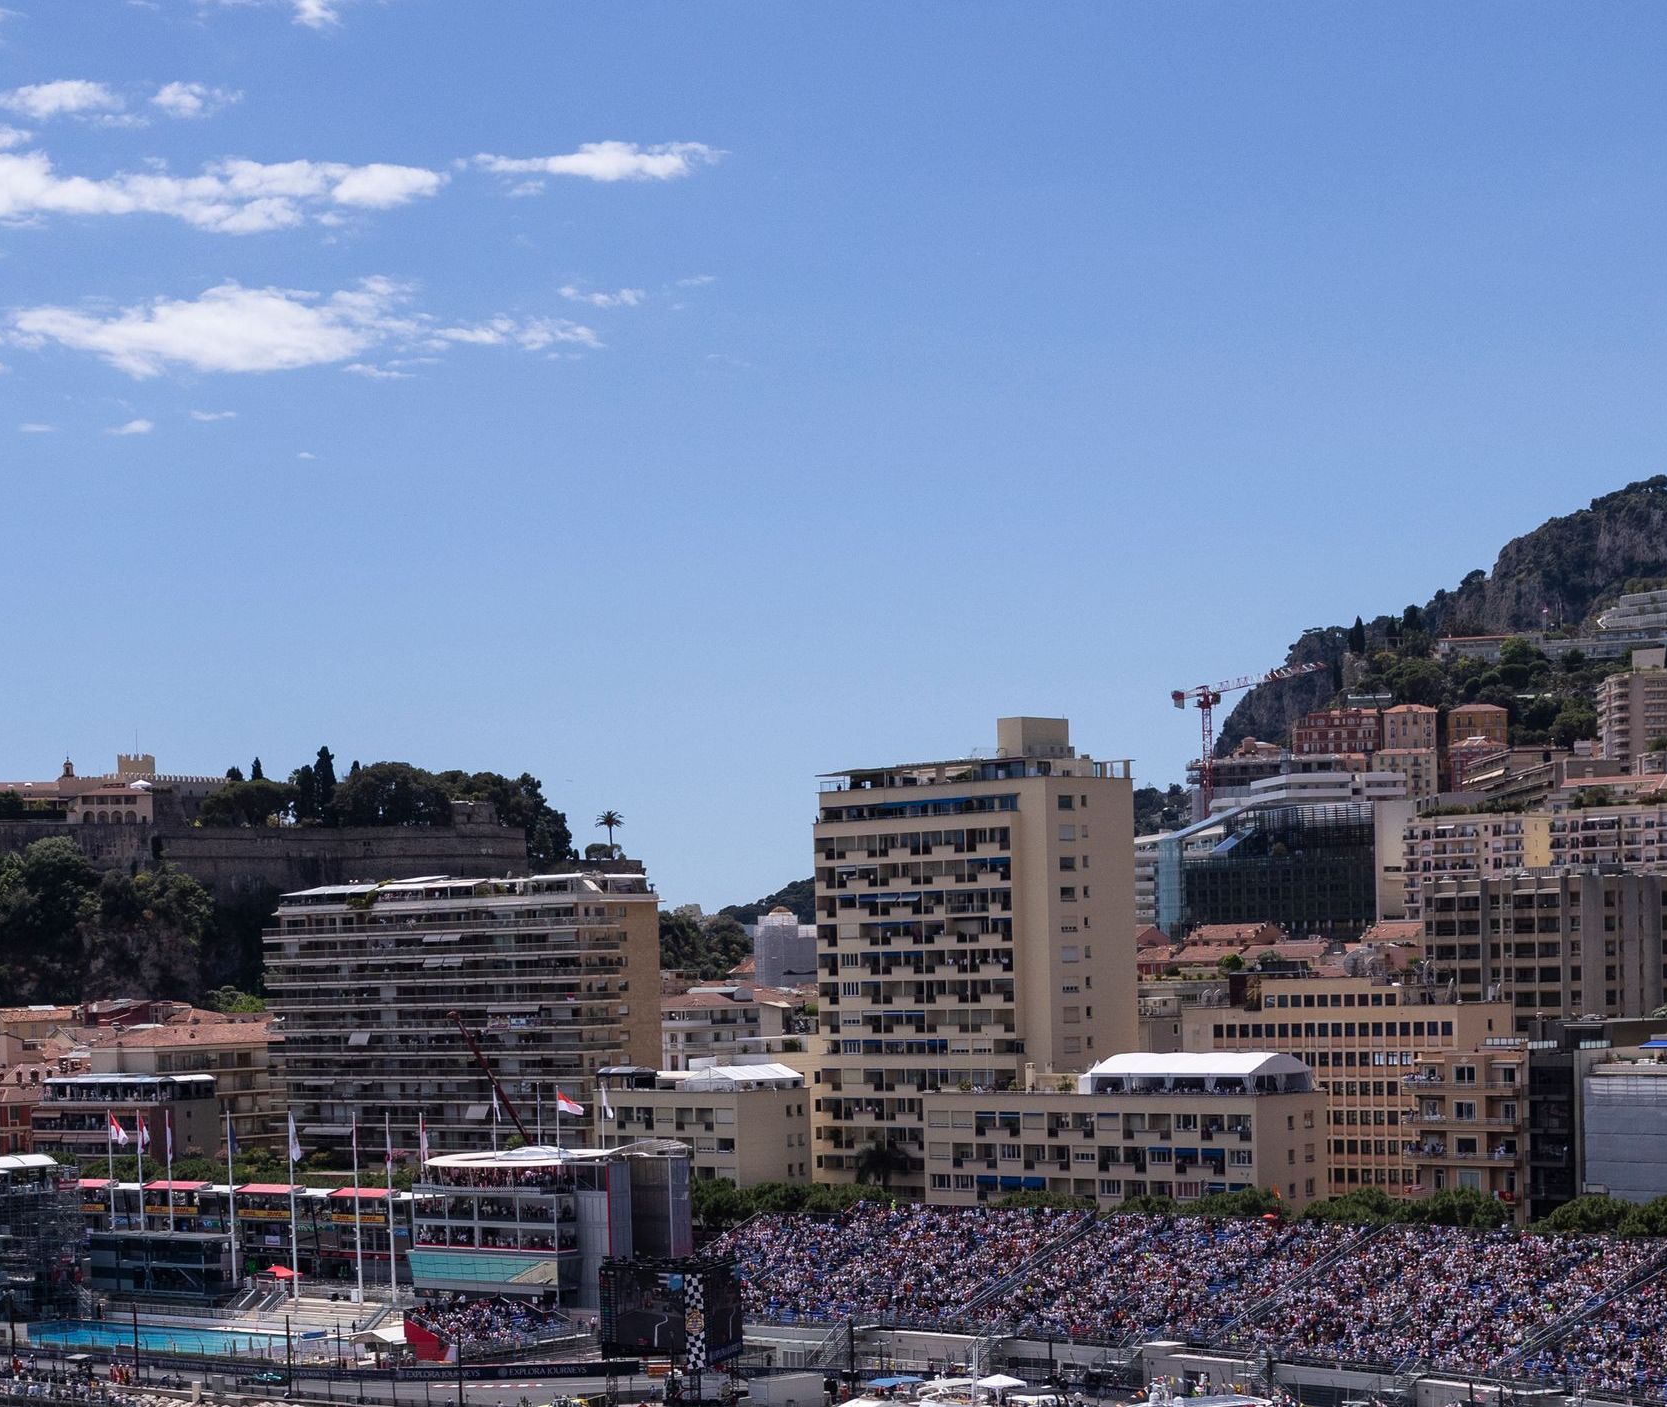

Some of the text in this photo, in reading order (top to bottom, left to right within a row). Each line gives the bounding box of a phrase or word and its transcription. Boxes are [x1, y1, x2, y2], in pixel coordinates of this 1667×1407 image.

[406, 1370, 440, 1378] EXPLORA
[509, 1366, 587, 1376] EXPLORA JOURNEYS
